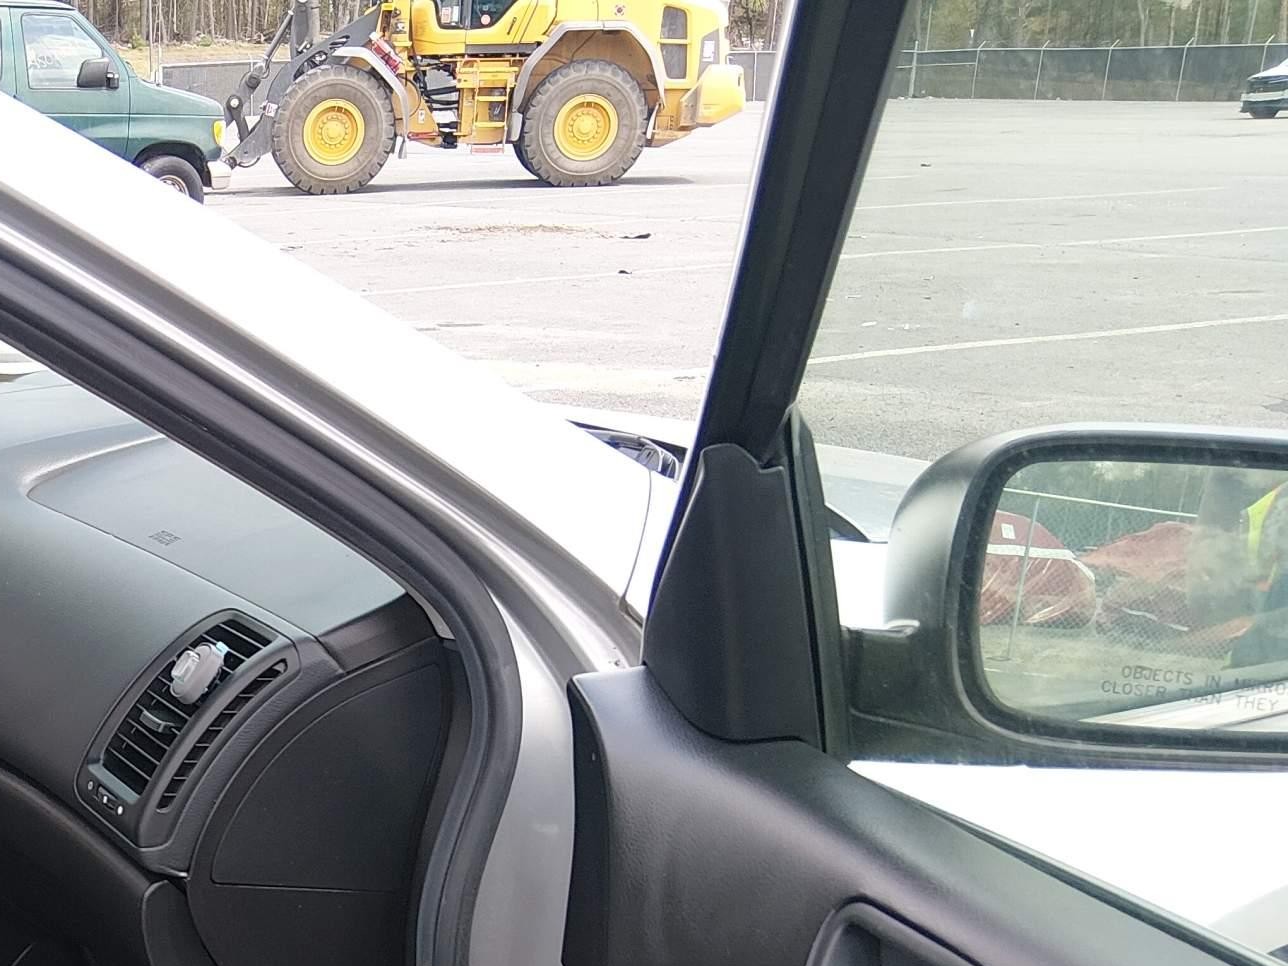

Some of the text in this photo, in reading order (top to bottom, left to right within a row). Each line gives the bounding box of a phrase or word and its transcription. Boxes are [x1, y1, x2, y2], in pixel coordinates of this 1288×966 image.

[1121, 665, 1193, 685] OBJECTS
[1206, 674, 1221, 688] IN
[1100, 680, 1167, 697] CLOSER
[1236, 694, 1279, 711] THEY
